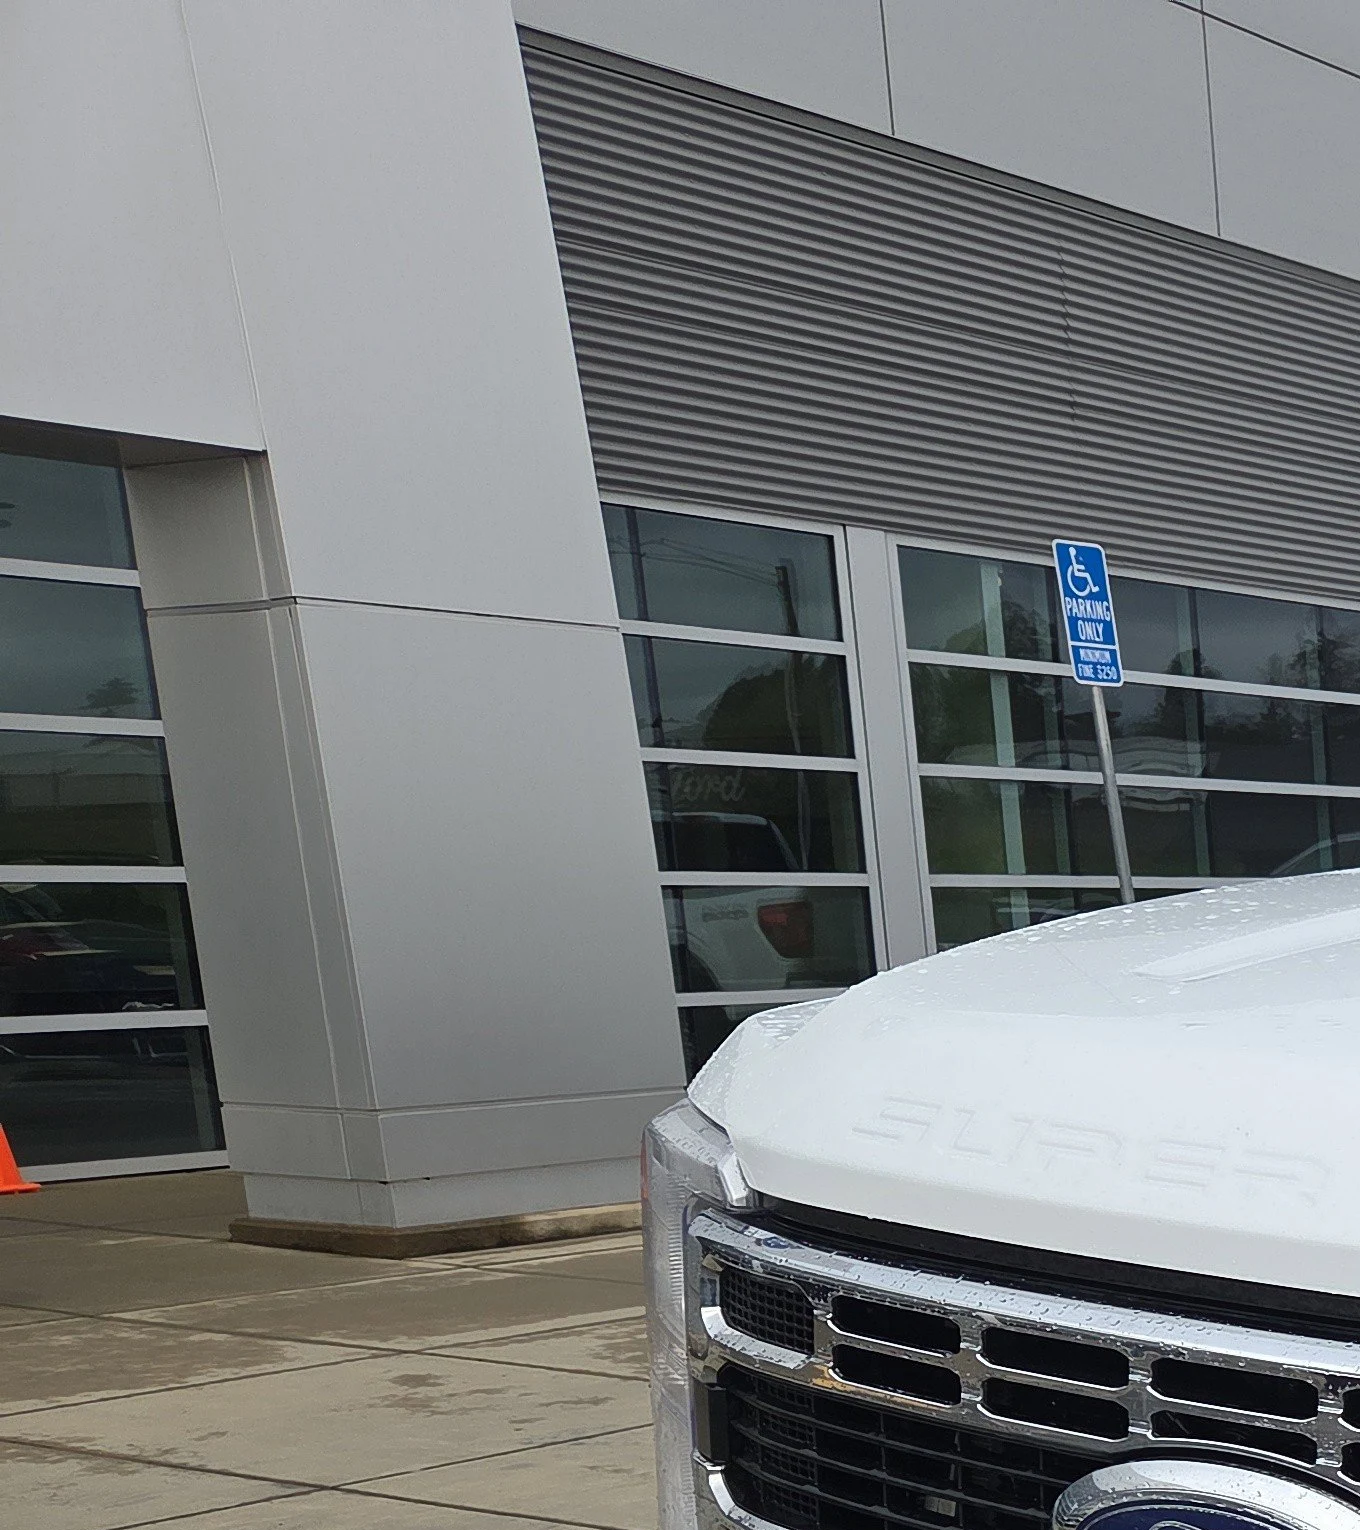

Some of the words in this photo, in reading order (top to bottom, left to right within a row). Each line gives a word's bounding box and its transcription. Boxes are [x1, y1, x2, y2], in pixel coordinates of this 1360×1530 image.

[1066, 597, 1110, 621] PARKING
[1077, 620, 1104, 641] ONLY
[850, 1093, 1334, 1208] SUPER
